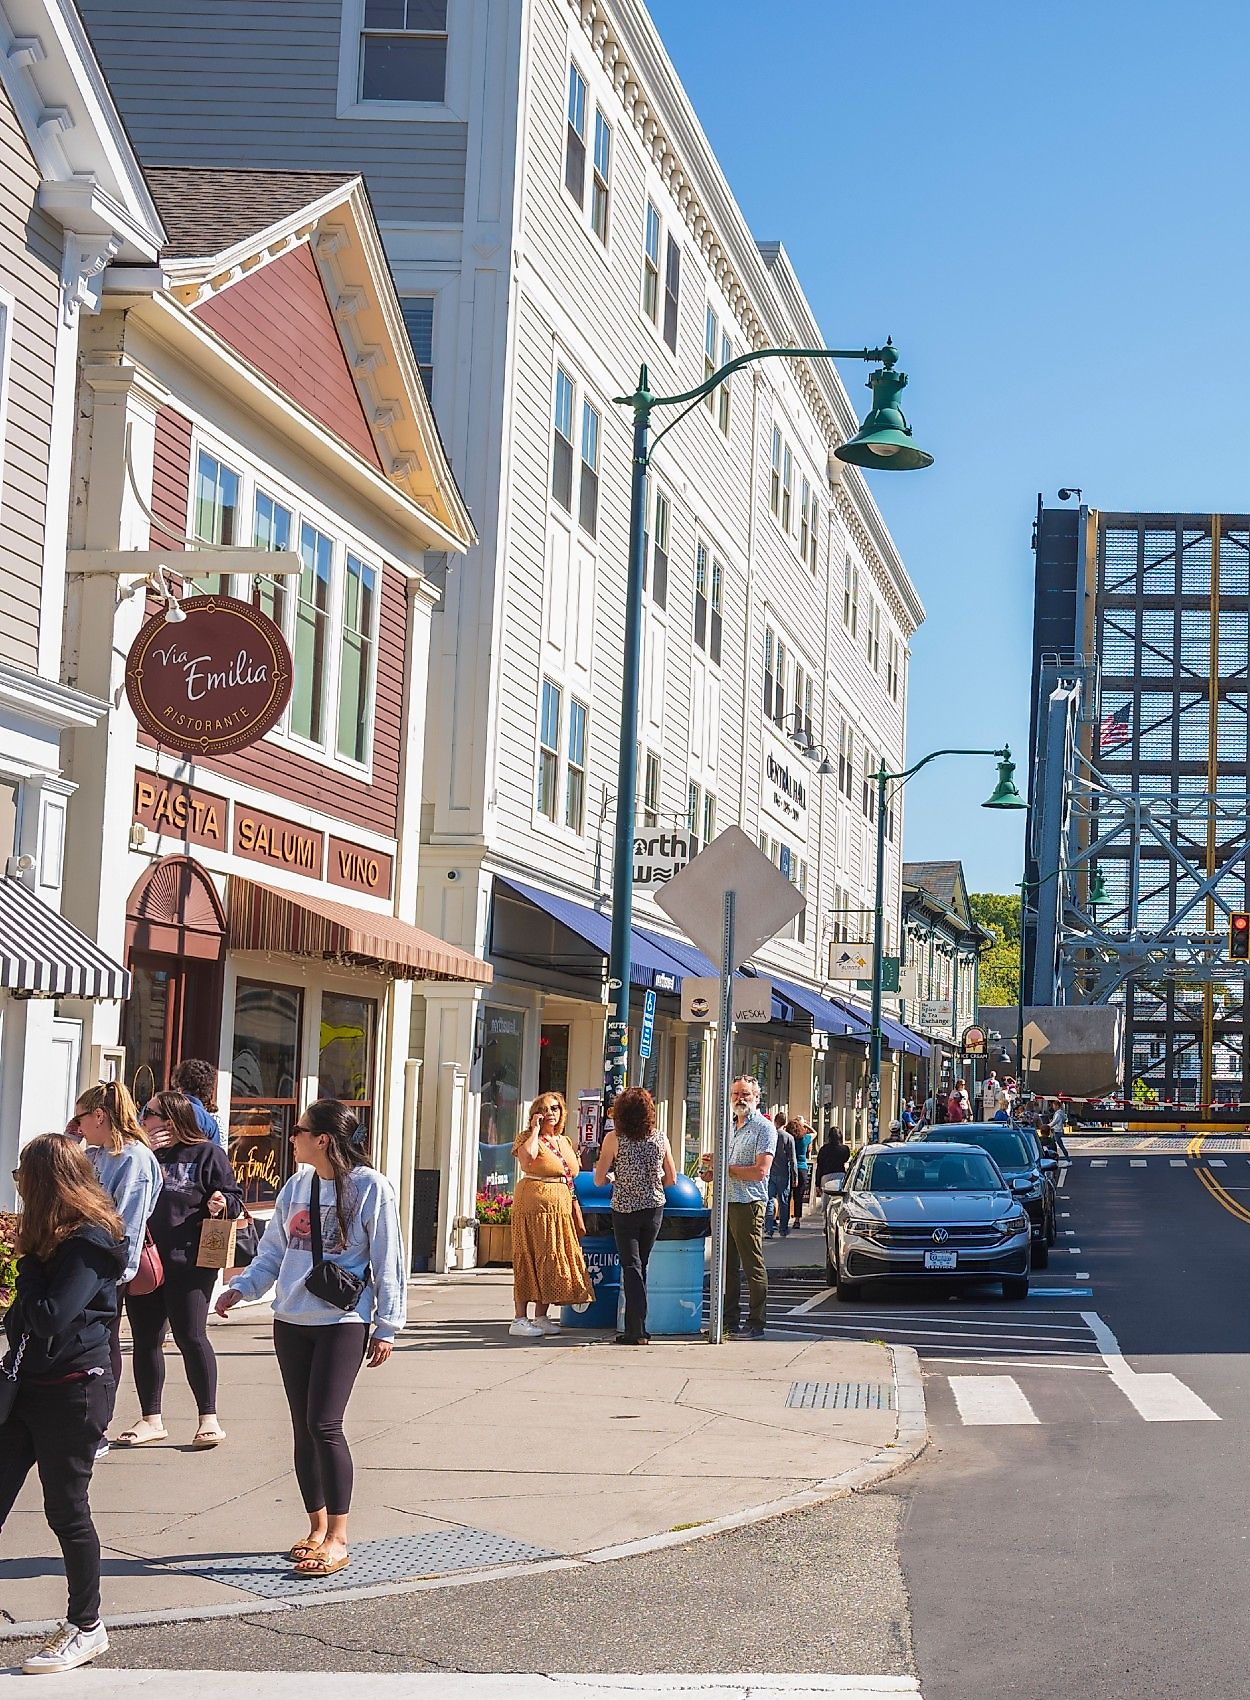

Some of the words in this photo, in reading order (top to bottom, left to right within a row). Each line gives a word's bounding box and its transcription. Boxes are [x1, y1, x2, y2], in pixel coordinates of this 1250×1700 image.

[152, 643, 188, 666] Via
[183, 649, 268, 701] Emilia
[163, 705, 250, 731] RISTORANTE
[135, 781, 220, 839] PASTA
[238, 818, 316, 870] SALUMI
[338, 849, 380, 888] VINO
[585, 1106, 594, 1142] FIRE
[247, 1145, 280, 1190] Emilia
[584, 1253, 620, 1267] YCLING
